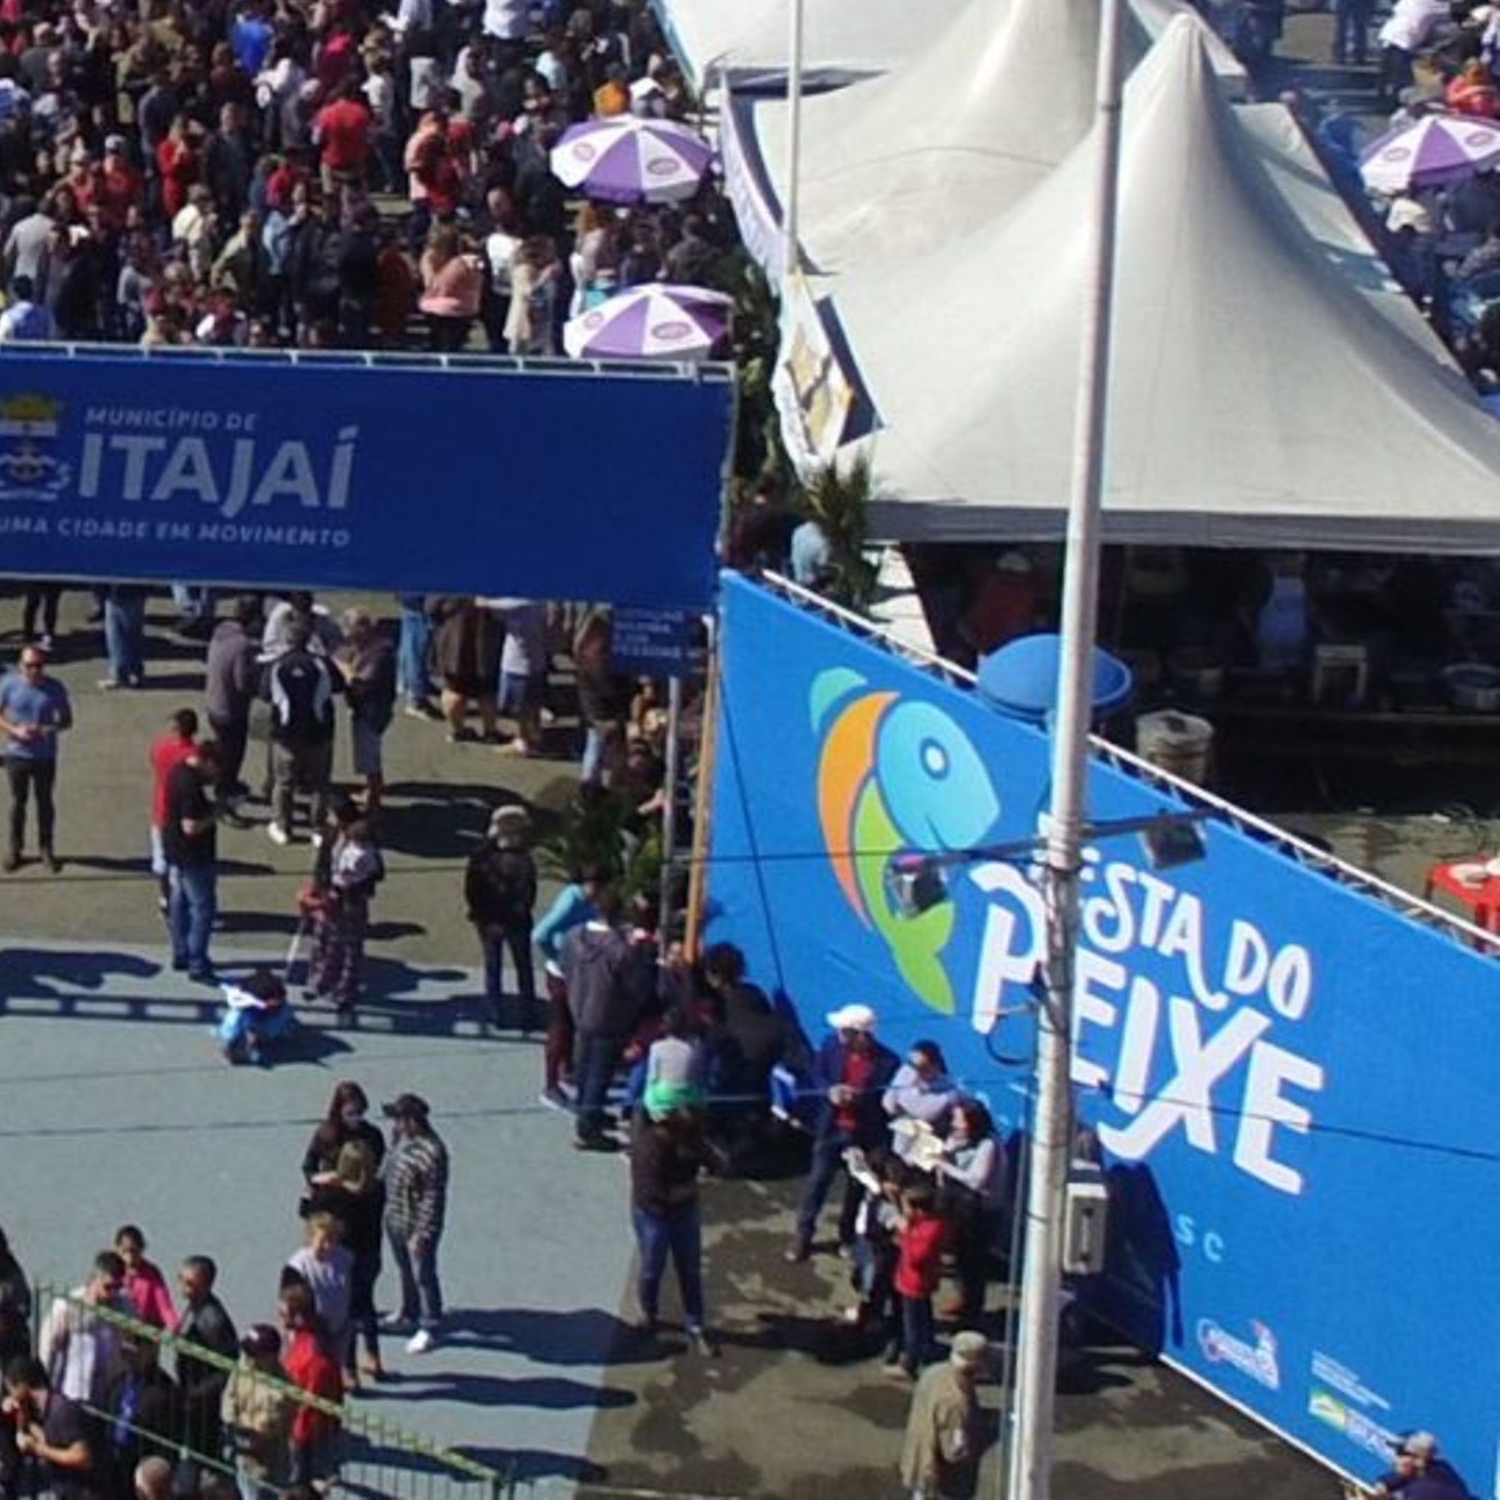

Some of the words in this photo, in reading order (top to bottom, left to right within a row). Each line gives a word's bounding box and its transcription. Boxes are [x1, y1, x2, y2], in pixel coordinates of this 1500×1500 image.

[85, 406, 220, 430] MUNICÍPIO
[226, 411, 257, 431] DE
[78, 425, 359, 519] ITAJAÍ
[57, 517, 147, 539] CIDADE
[156, 521, 191, 540] EM
[198, 522, 350, 547] MOVIMENTO
[1223, 920, 1312, 1021] DO
[968, 861, 1325, 1195] PEIXE
